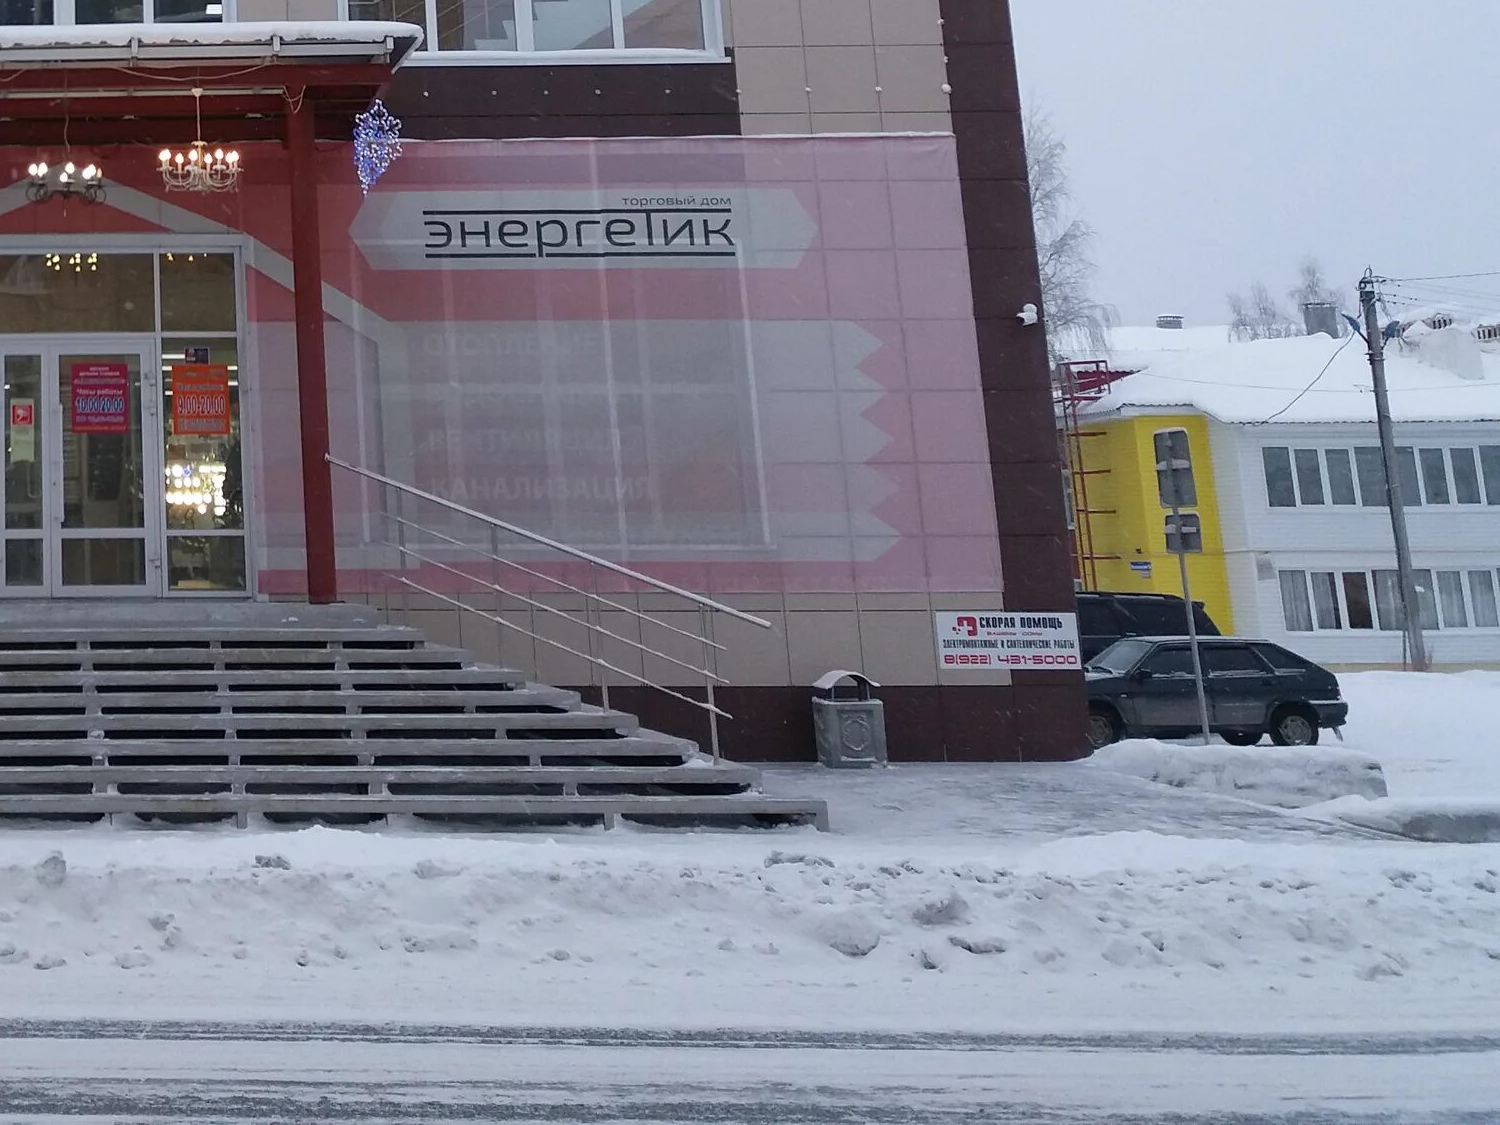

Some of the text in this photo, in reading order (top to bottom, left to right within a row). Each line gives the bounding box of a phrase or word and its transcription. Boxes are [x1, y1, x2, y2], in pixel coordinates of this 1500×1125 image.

[621, 195, 731, 207] торговый дом
[979, 617, 1063, 630] СКОРАЯ ПОМОЩЬ
[1053, 639, 1075, 649] РАБОТЫ
[944, 654, 1078, 665] 8(922) 431-5000
